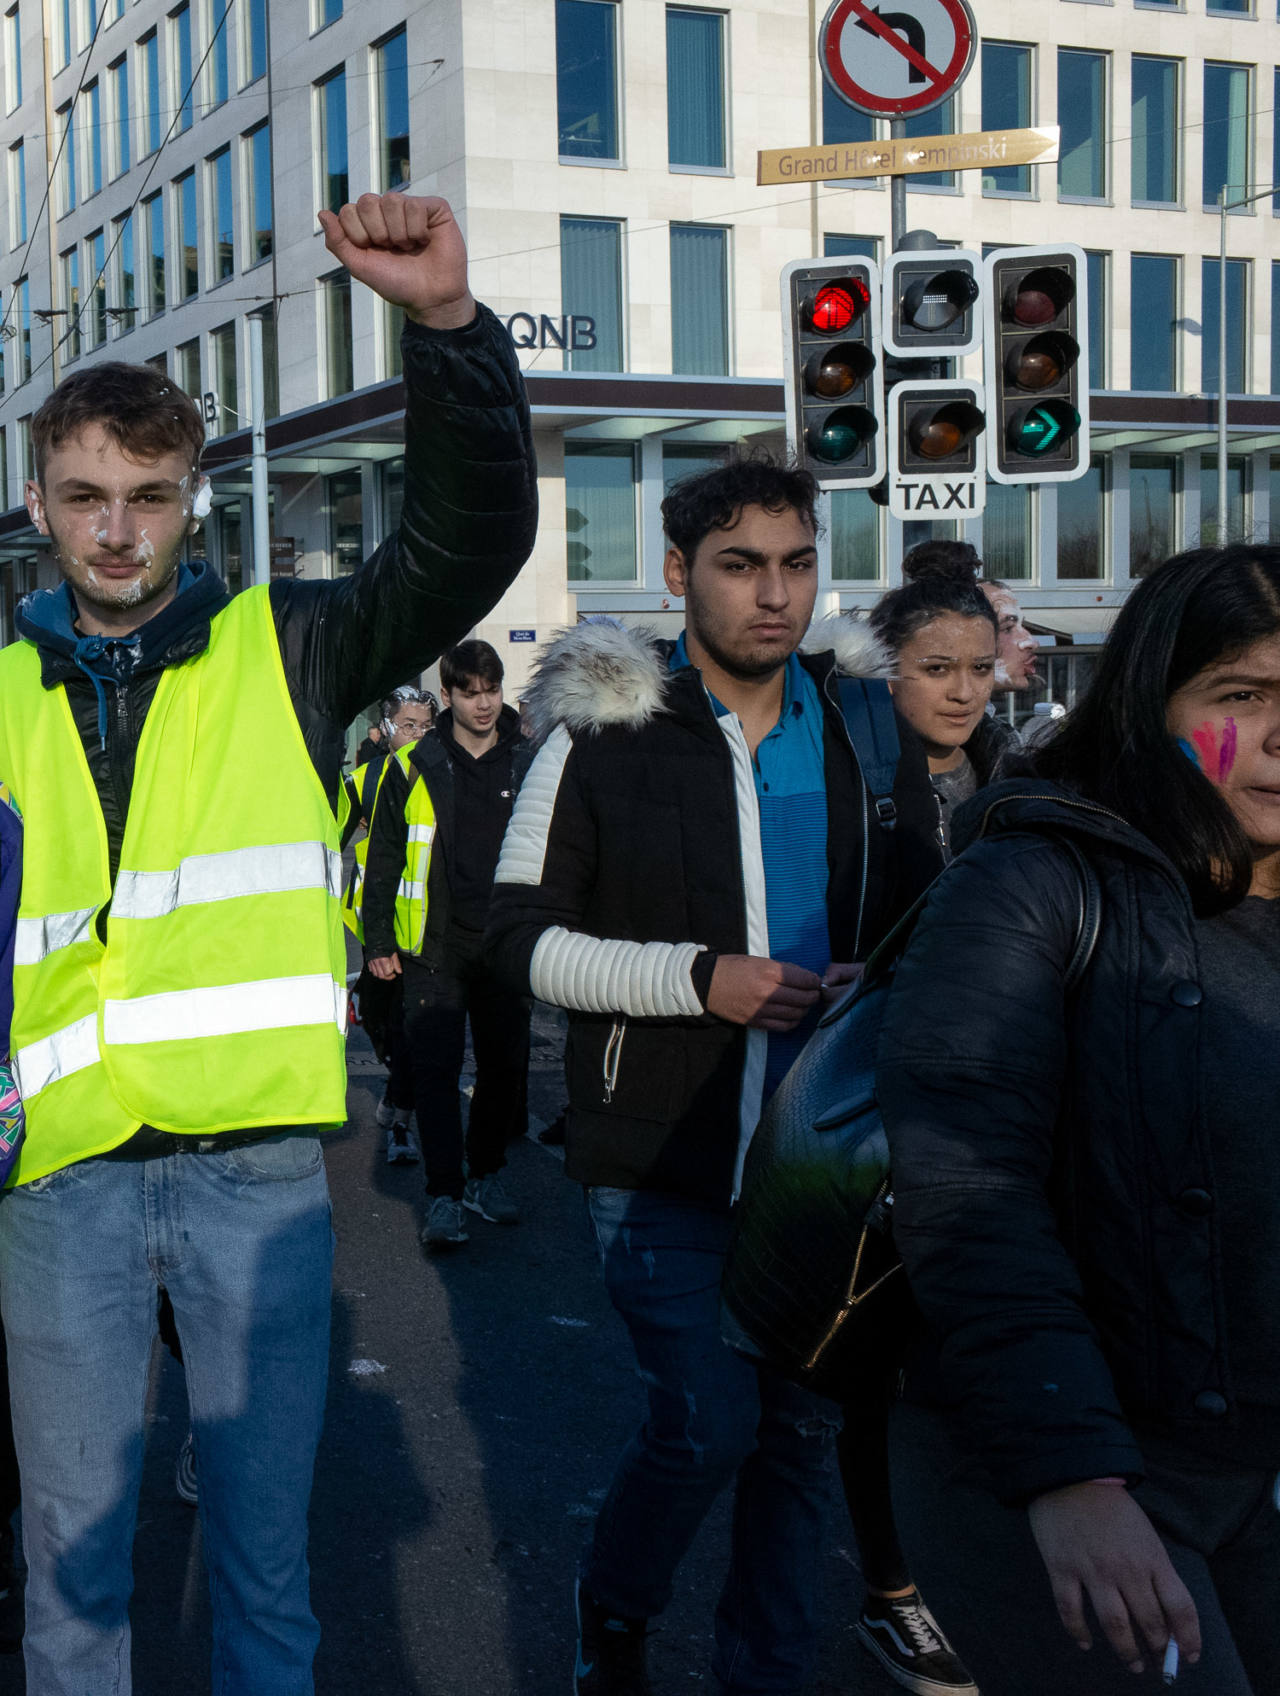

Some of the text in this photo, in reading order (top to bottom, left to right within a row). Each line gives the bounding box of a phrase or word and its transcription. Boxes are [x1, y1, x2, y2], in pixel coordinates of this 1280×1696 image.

[779, 136, 1007, 177] Grand Hôtel Kempinski
[507, 312, 598, 350] QNB
[895, 482, 975, 510] TAXI
